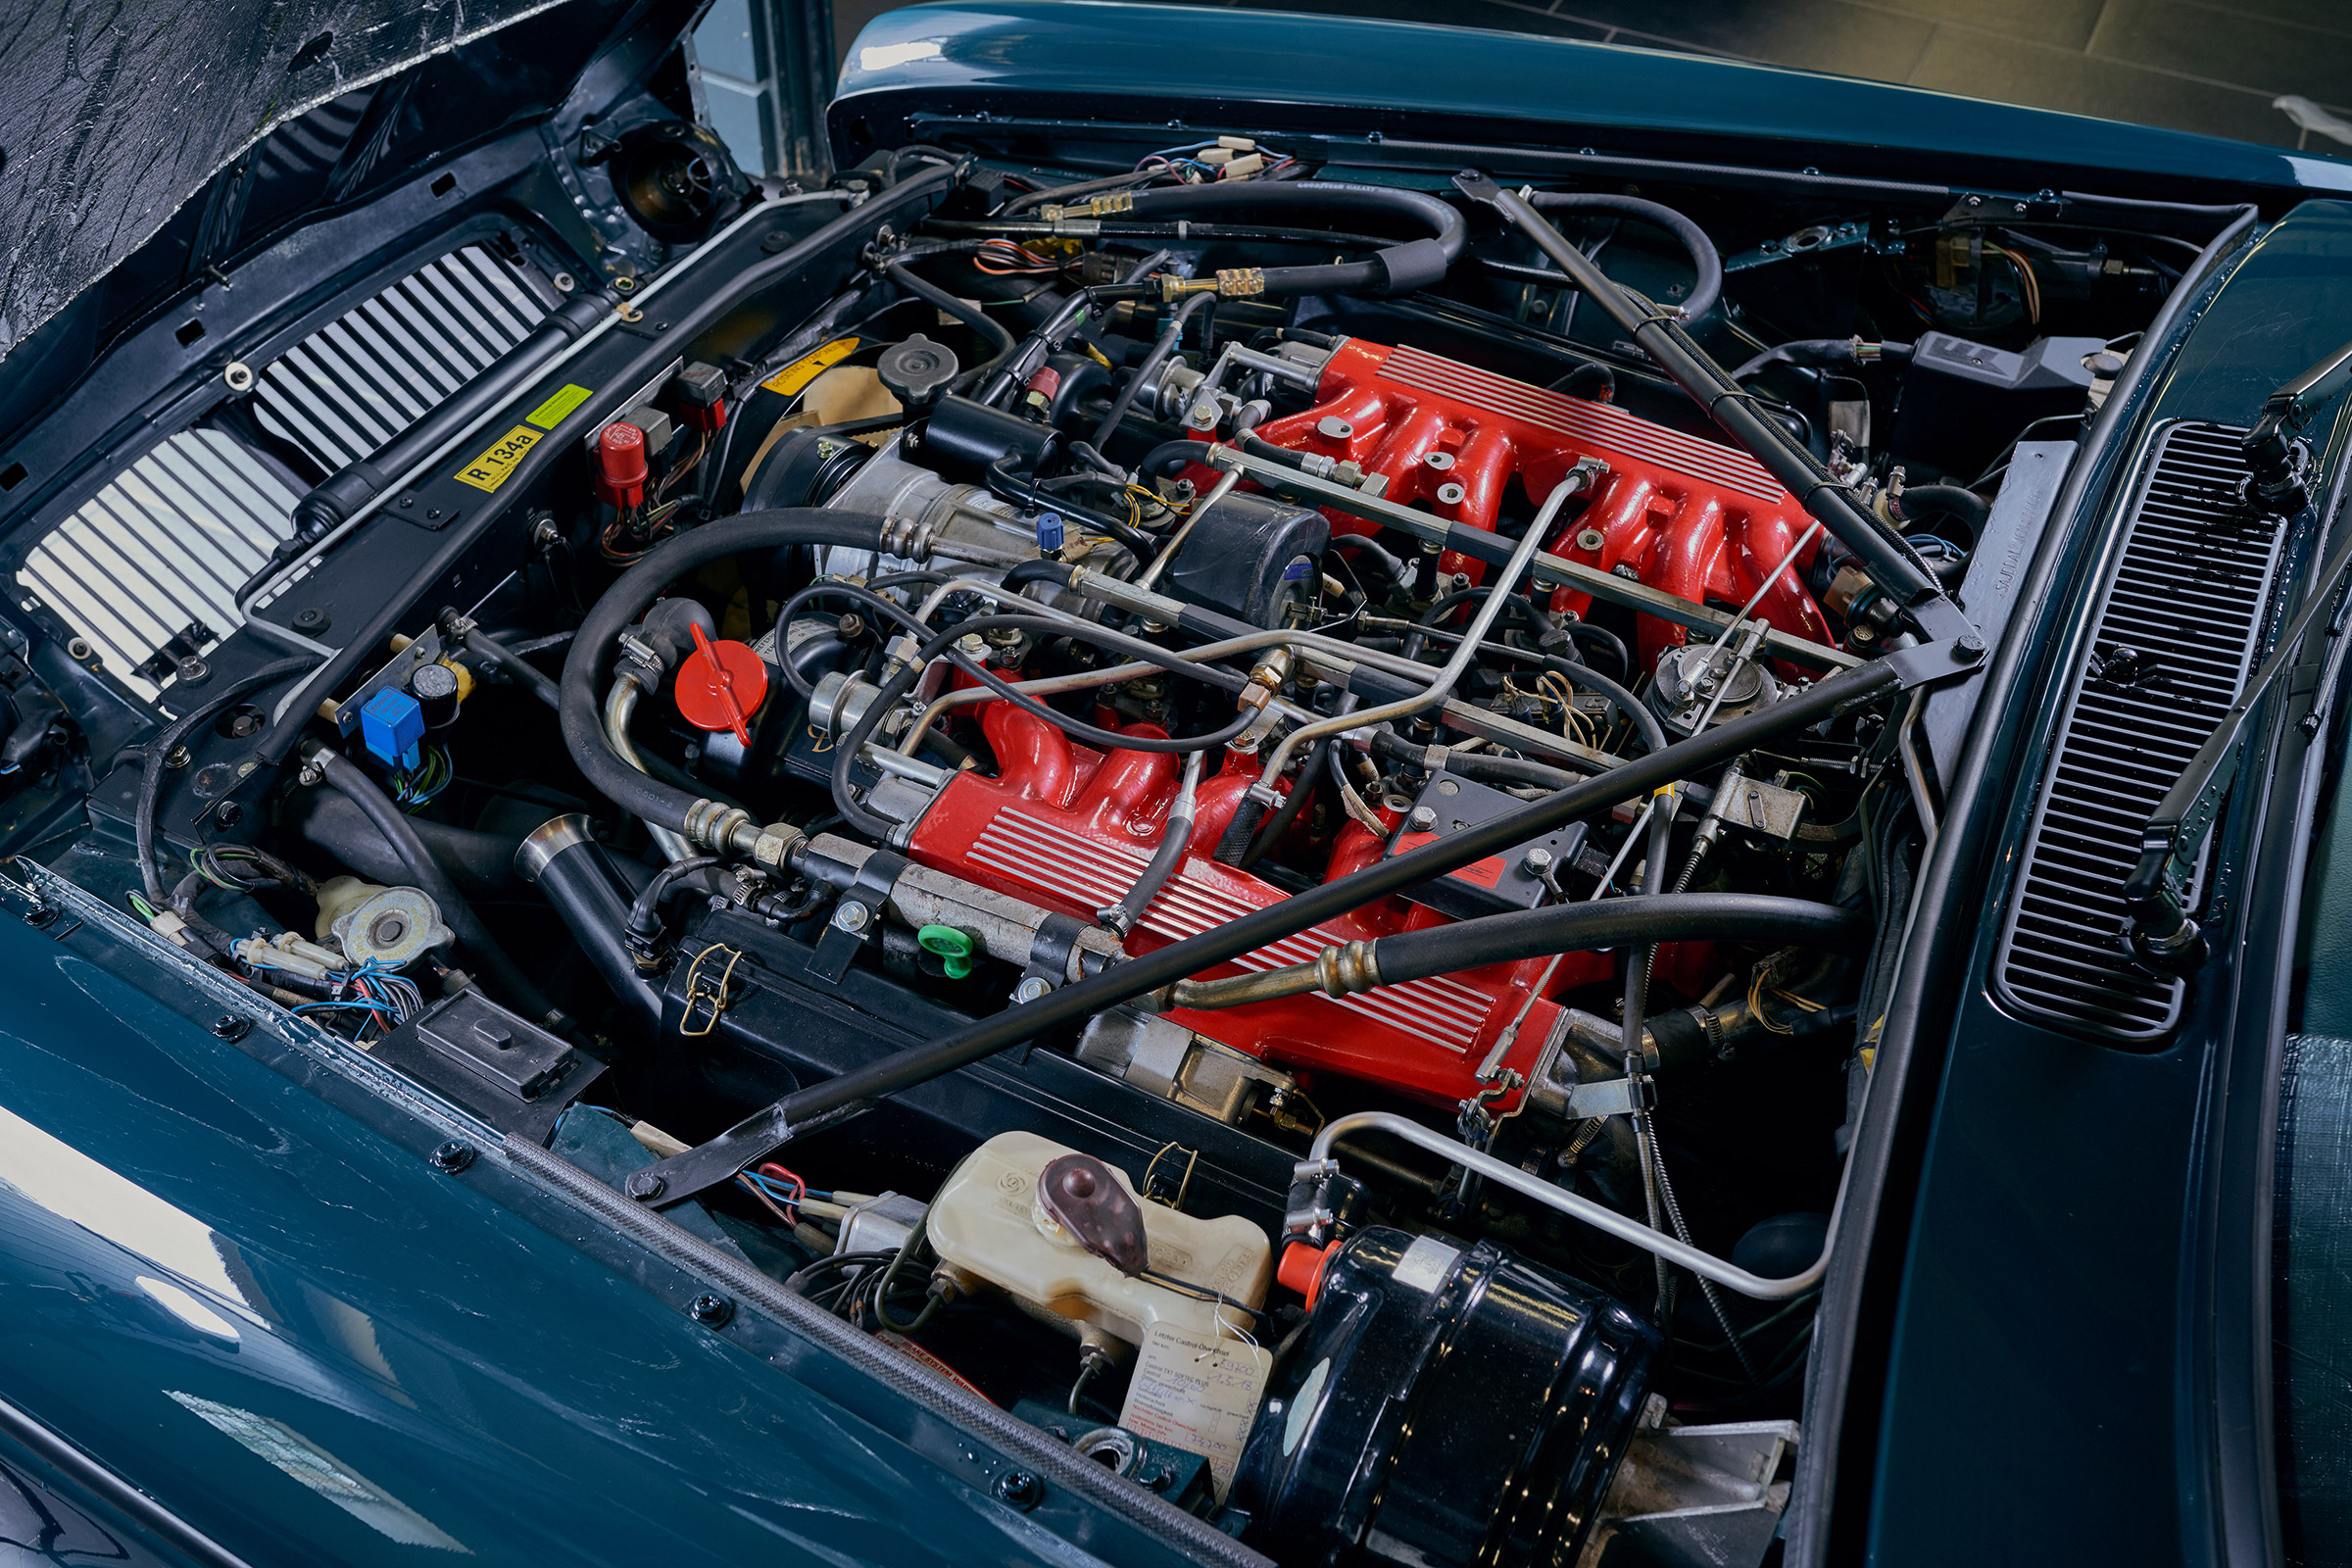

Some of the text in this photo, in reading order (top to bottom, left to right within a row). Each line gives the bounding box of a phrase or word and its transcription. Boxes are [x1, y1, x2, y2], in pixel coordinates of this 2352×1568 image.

[1347, 183, 1376, 192] GALAXY
[466, 468, 492, 481] R
[486, 434, 534, 466] 134a
[1154, 1330, 1175, 1344] Letzter
[925, 1356, 955, 1378] SYSTEM
[1143, 1368, 1161, 1378] Castrol
[1145, 1361, 1163, 1372] Castrol
[1195, 1378, 1209, 1387] PLUS
